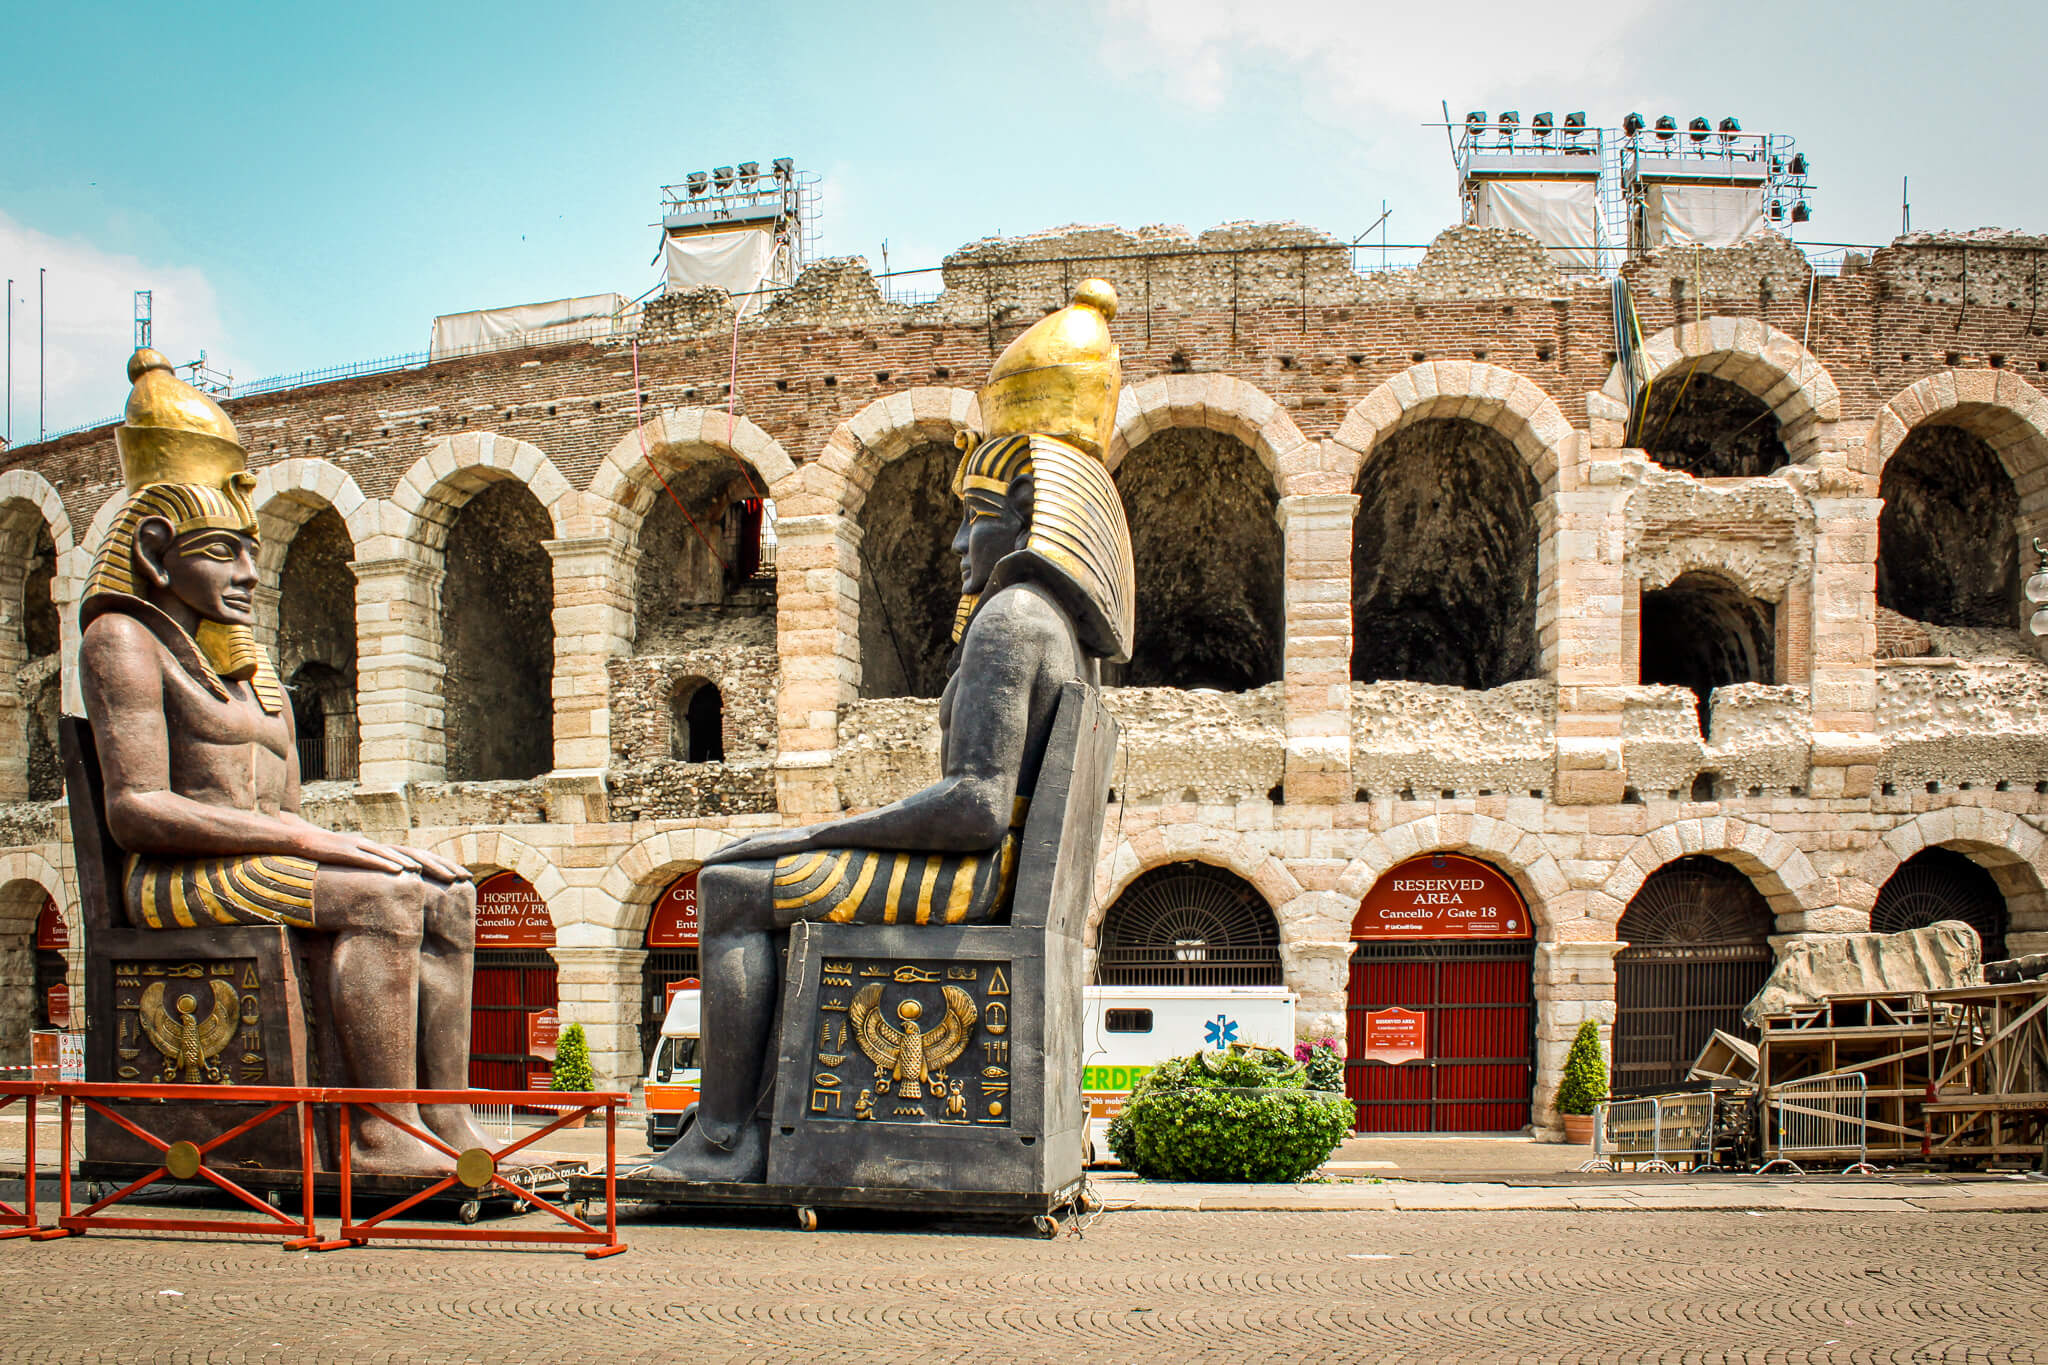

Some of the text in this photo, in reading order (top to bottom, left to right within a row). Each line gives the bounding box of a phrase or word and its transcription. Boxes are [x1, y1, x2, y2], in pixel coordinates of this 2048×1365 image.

[1393, 879, 1486, 892] RESERVED
[1412, 893, 1464, 905] AREA
[475, 904, 520, 915] STAMPA
[1379, 906, 1497, 920] Cancello / Gate 18
[475, 918, 516, 927] Cancello
[525, 917, 549, 927] Gate
